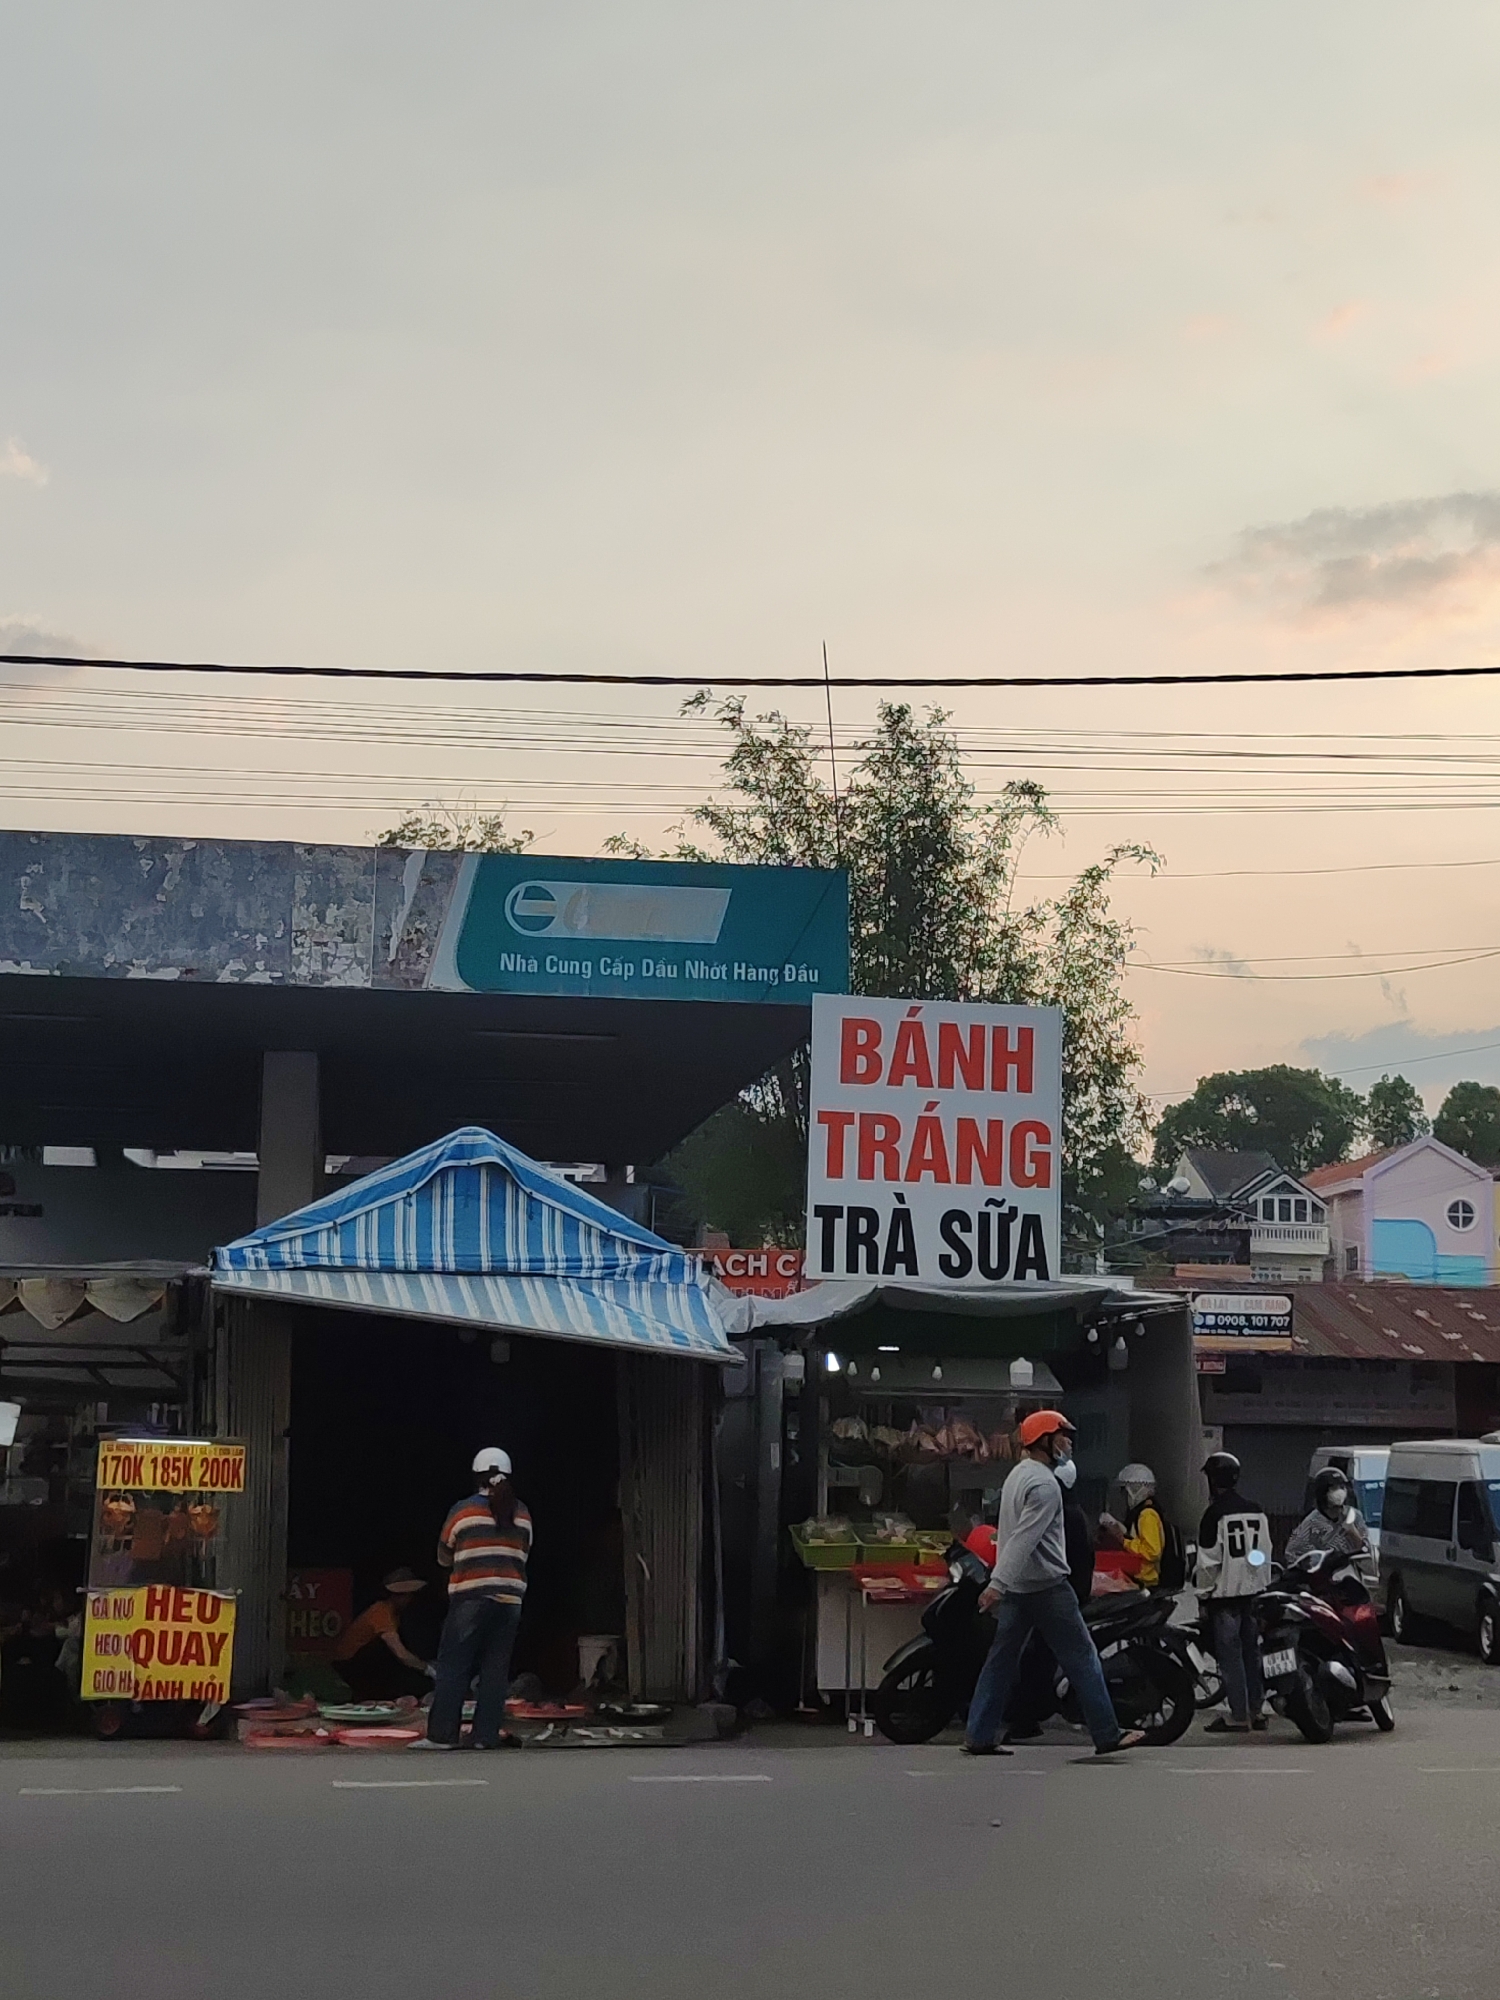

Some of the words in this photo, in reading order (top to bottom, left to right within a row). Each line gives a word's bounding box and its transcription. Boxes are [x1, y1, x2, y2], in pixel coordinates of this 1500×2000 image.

[500, 953, 538, 973] Nhà
[546, 955, 592, 979] Cung
[600, 956, 635, 981] Cấp
[642, 957, 678, 978] Dầu
[685, 960, 728, 981] Nhớt
[733, 961, 779, 986] Hàng
[784, 963, 819, 983] Đầu
[840, 1006, 1035, 1094] BÁNH
[817, 1101, 1052, 1189] TRÁNG
[814, 1192, 920, 1277] TRÀ
[938, 1197, 1050, 1281] SỮA
[1217, 1315, 1249, 1326] 0908.
[1251, 1316, 1269, 1326] 101
[1270, 1316, 1291, 1327] 707
[101, 1455, 145, 1486] 170K
[150, 1456, 194, 1487] 185K
[198, 1457, 243, 1489] 200K
[290, 1609, 343, 1638] HEO
[95, 1633, 122, 1656] HEO
[132, 1628, 229, 1669] QUAY
